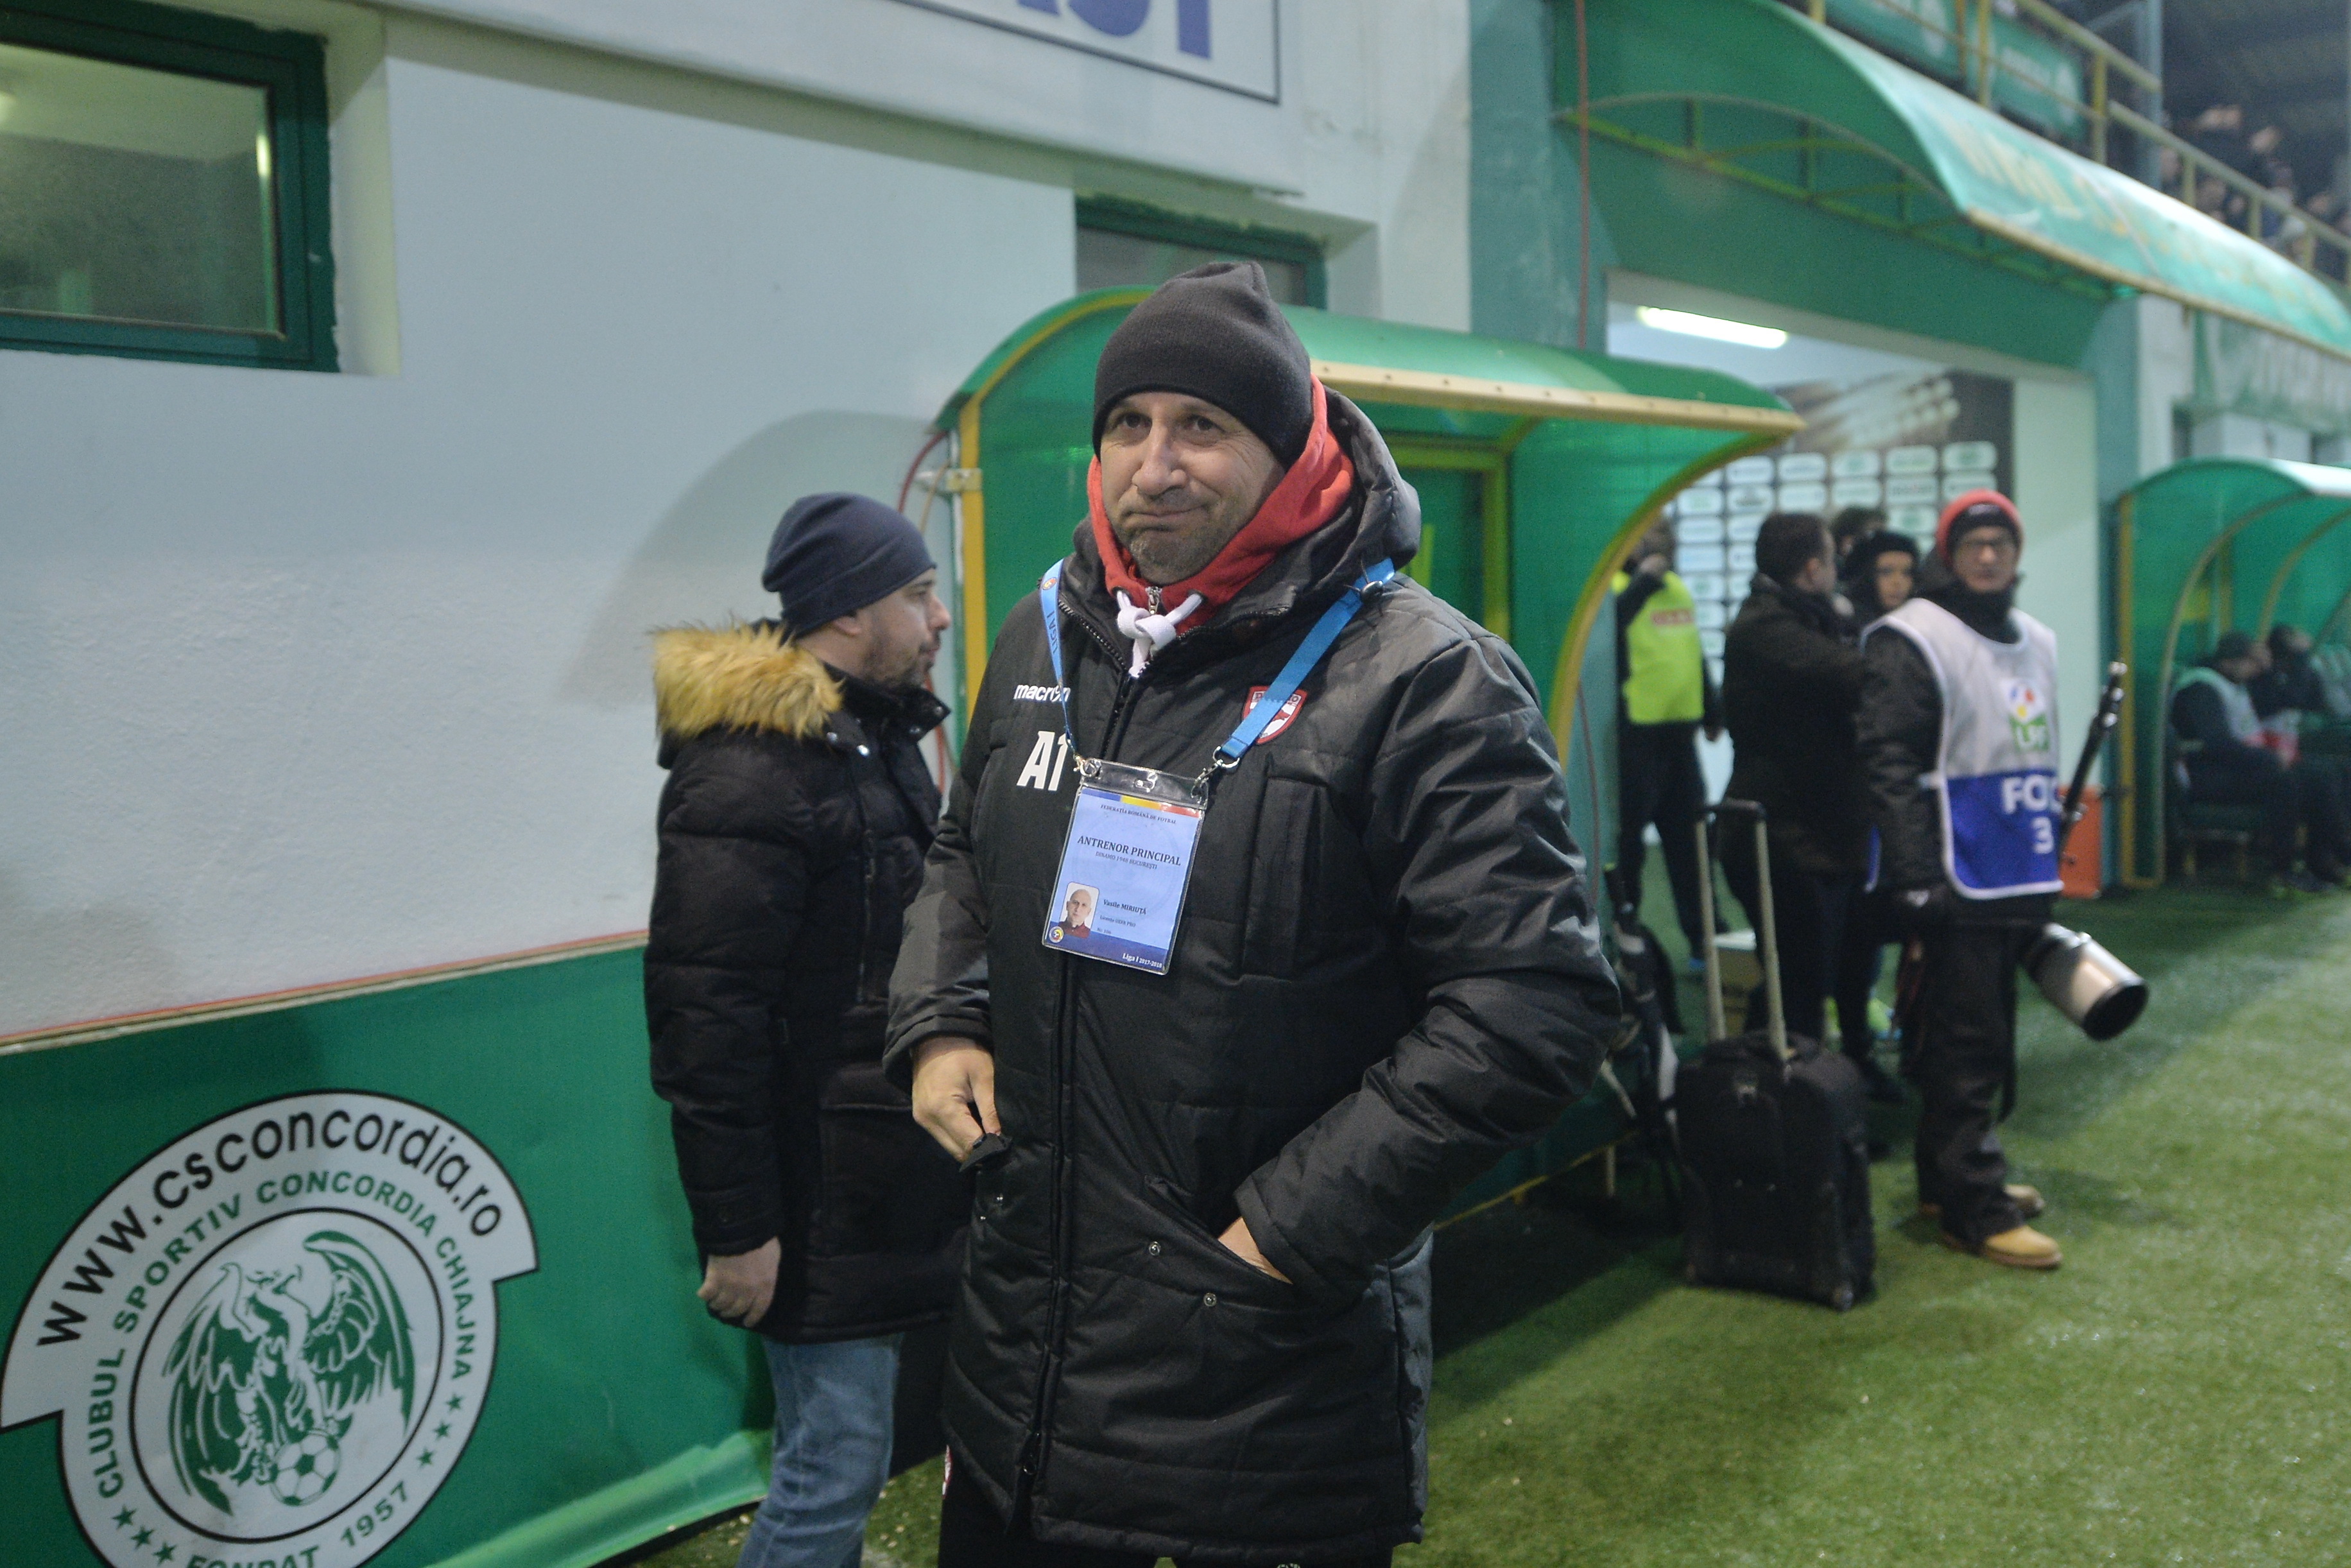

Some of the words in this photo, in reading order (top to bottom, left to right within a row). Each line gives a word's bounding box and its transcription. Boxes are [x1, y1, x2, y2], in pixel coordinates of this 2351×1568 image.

[1017, 730, 1069, 791] A1
[1077, 836, 1129, 854] ANTRENOR
[1130, 846, 1181, 866] PRINCIPAL
[2029, 816, 2054, 854] 3
[1096, 851, 1115, 861] DINAMO
[1103, 899, 1120, 908] Vasile
[1122, 952, 1135, 961] Liga
[1139, 958, 1162, 969] 2017-2018
[37, 1109, 503, 1347] www.csconcordia.ro
[87, 1347, 126, 1498] CLUBUL
[113, 1196, 243, 1335] SPORTIV
[255, 1170, 436, 1237] CONCORDIA
[435, 1236, 476, 1380] CHIAJNA
[340, 1481, 409, 1547] 1957
